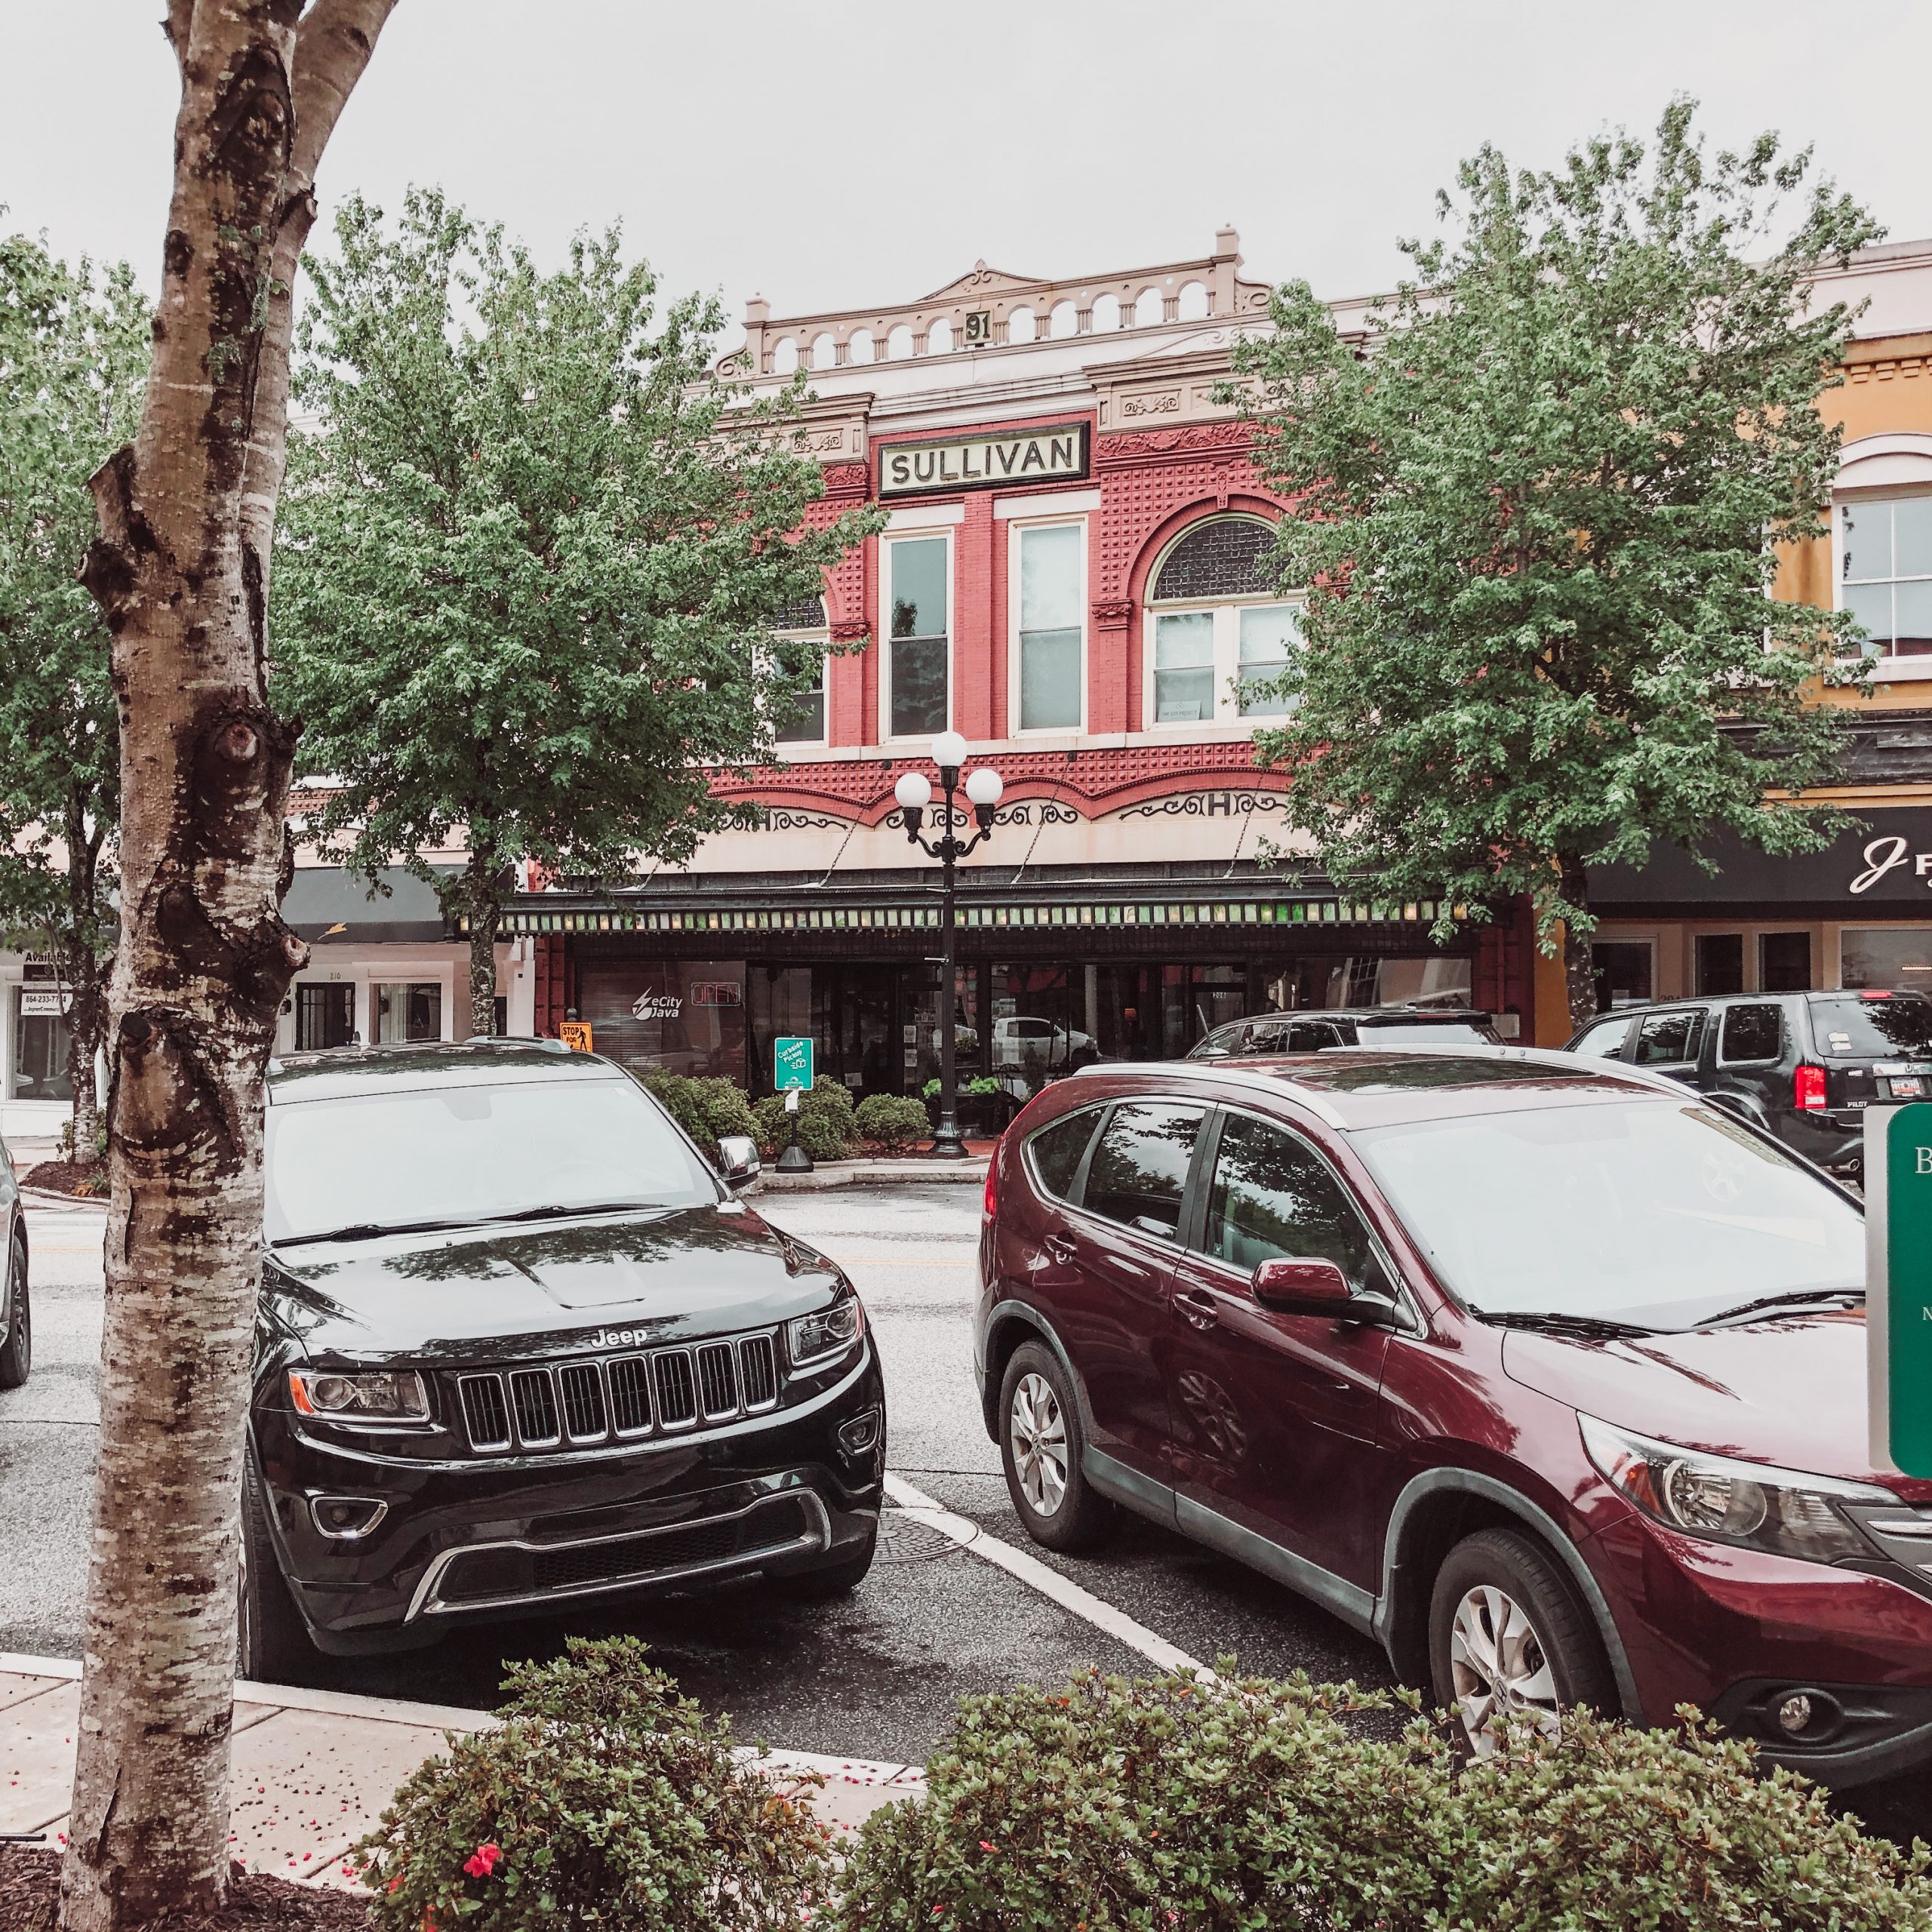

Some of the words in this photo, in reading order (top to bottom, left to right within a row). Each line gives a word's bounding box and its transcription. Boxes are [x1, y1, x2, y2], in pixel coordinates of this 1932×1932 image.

[966, 314, 990, 340] 91
[891, 437, 1072, 484] SULLIVAN
[652, 996, 682, 1009] eCity
[694, 984, 738, 1003] OPEN
[651, 1007, 679, 1018] Java
[778, 1041, 804, 1059] Curbside
[783, 1050, 802, 1063] Pickup
[590, 1329, 648, 1348] Jeep
